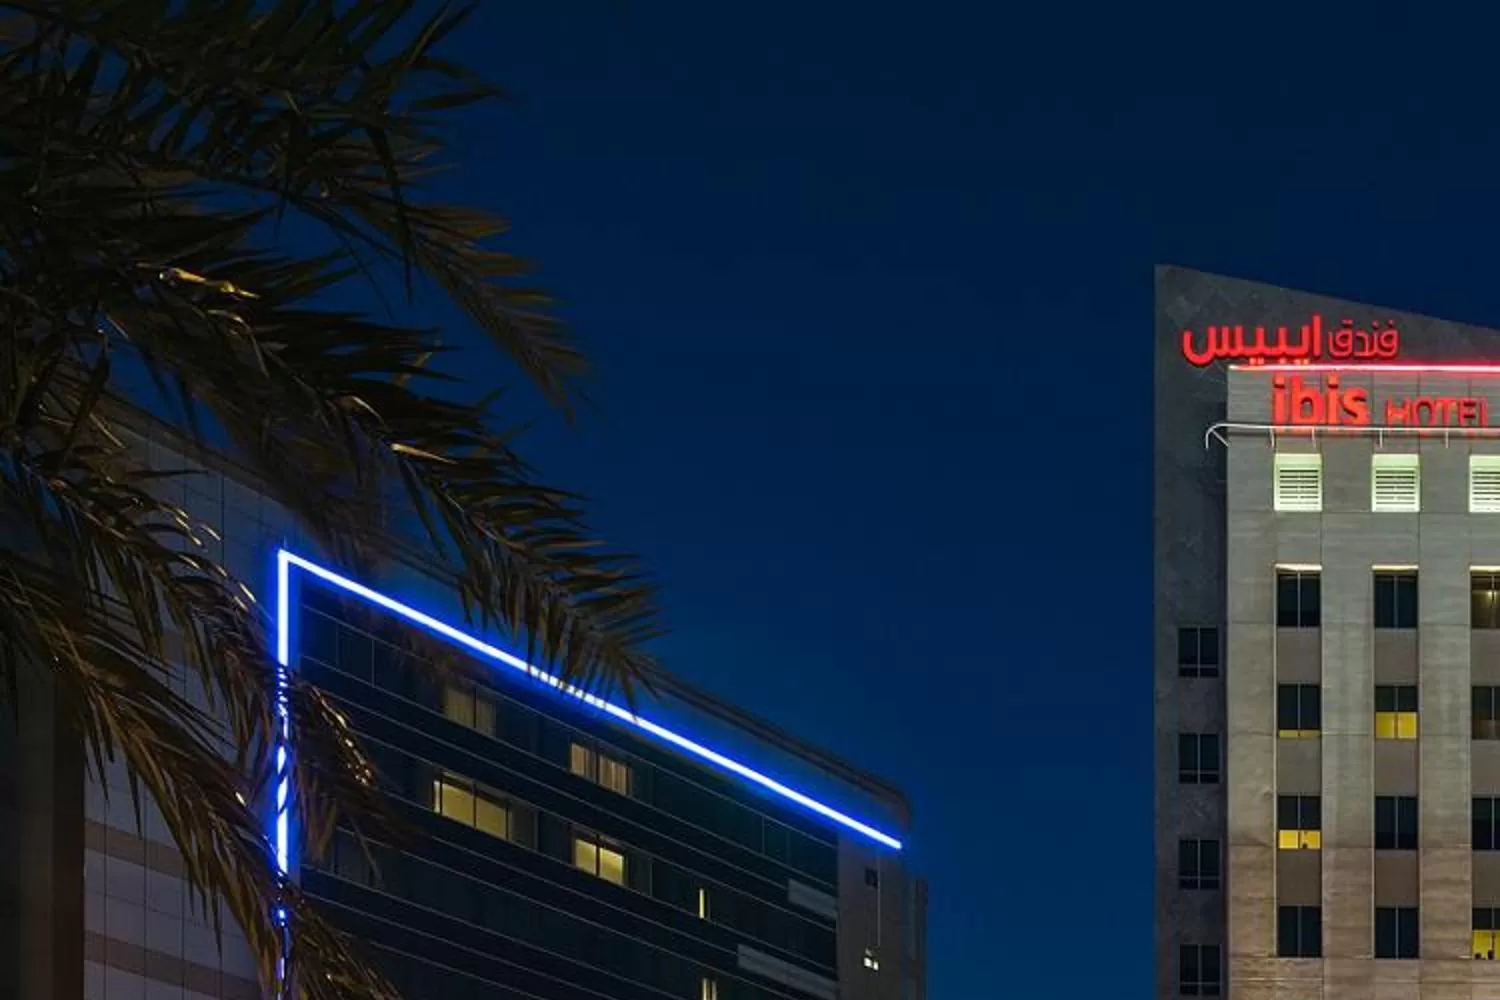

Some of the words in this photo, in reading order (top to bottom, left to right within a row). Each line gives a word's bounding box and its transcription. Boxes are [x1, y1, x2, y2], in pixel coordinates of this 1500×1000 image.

[1328, 319, 1399, 358] فندق
[1273, 371, 1371, 432] ibis
[1384, 396, 1499, 438] HOTEL
